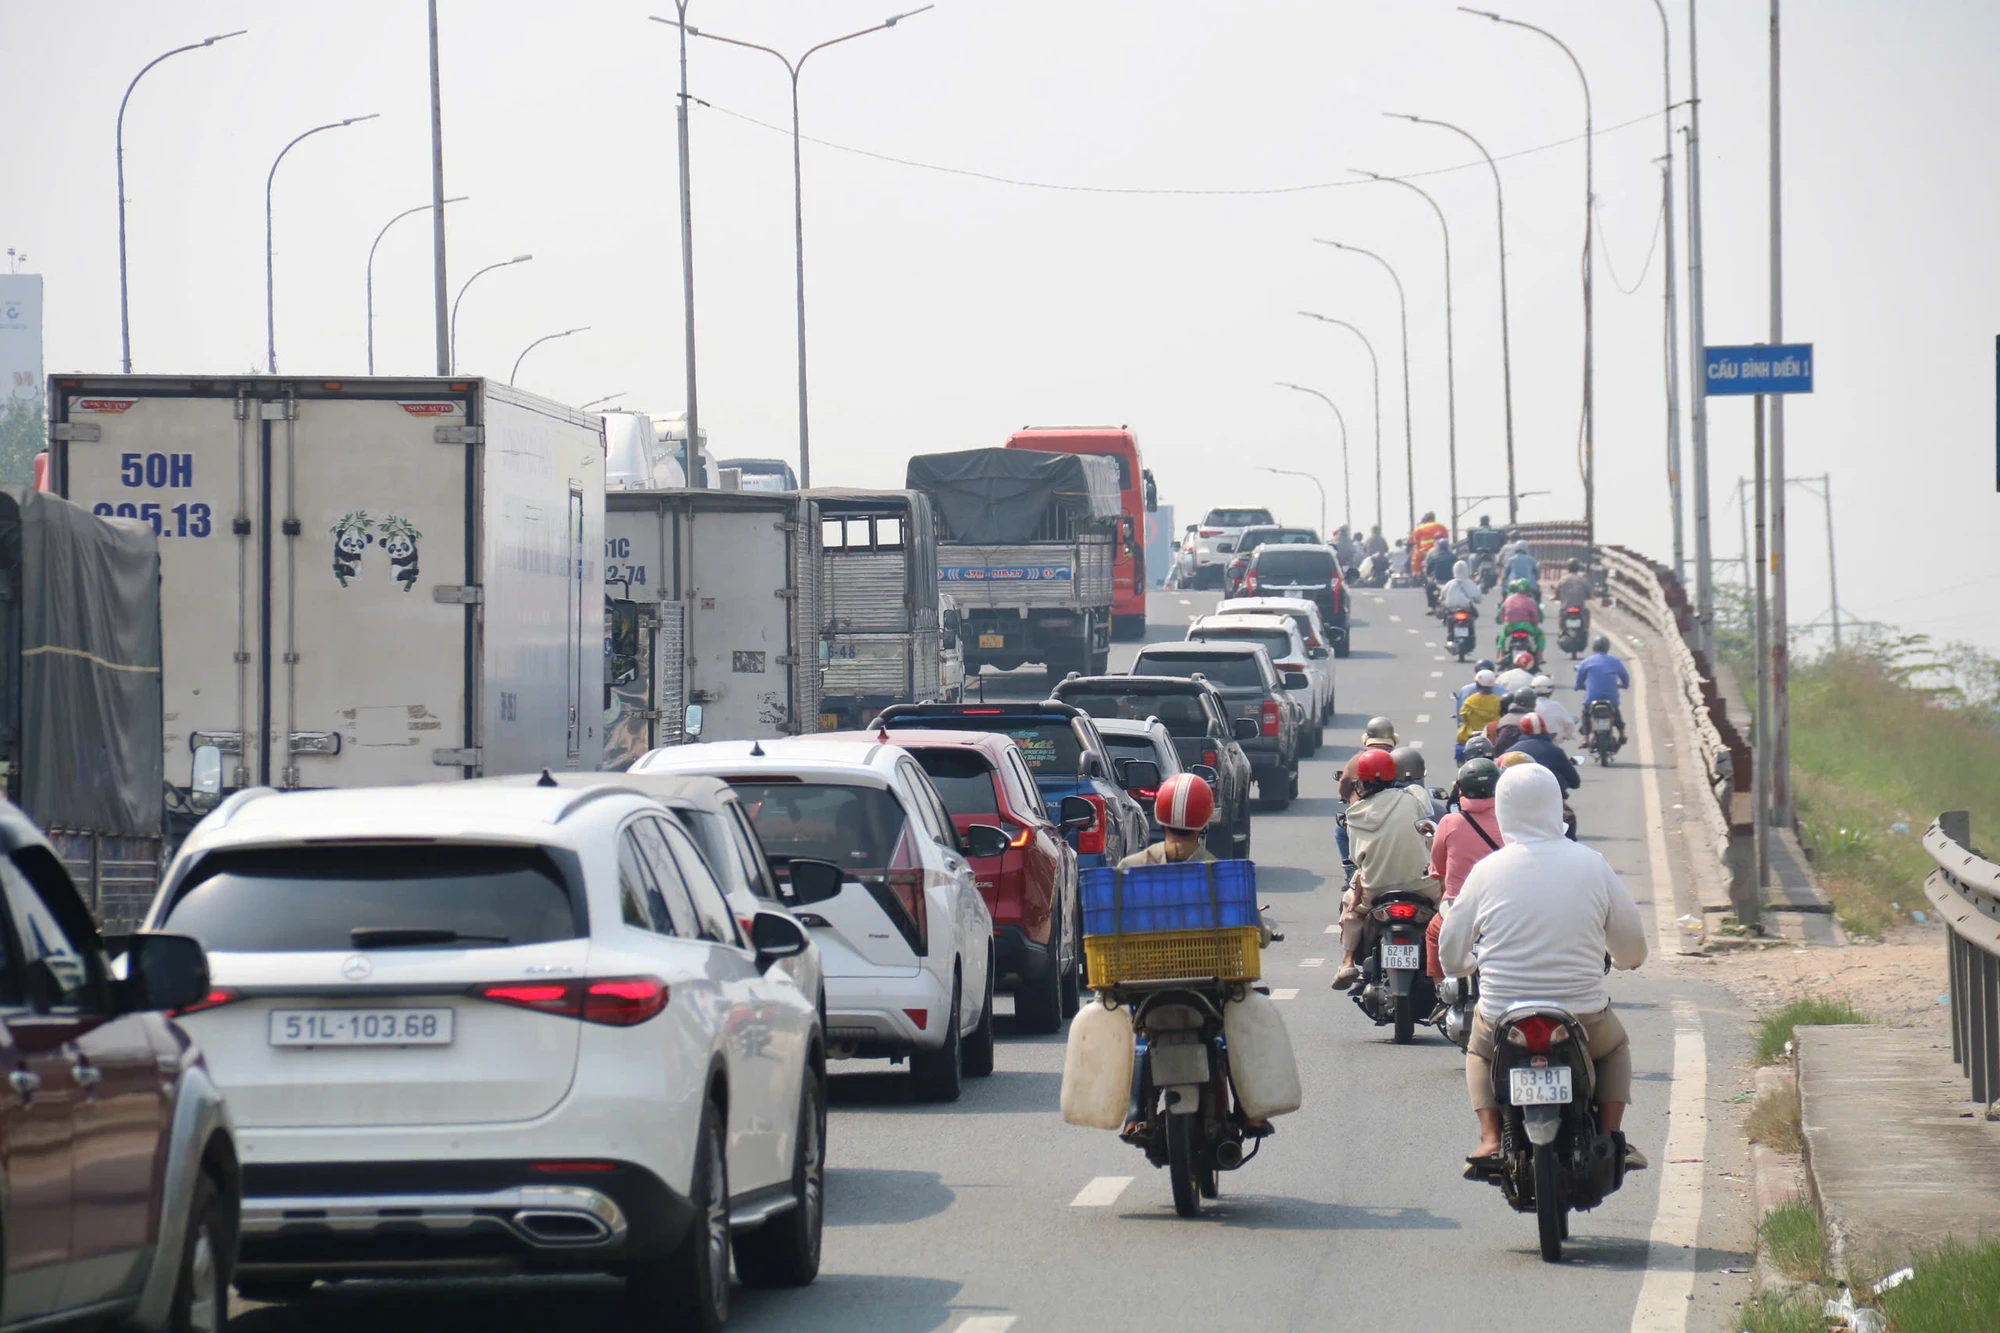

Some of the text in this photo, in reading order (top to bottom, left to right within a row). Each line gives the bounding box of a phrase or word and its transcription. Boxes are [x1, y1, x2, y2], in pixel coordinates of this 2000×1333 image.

[1802, 361, 1809, 377] 1
[121, 452, 192, 488] 50H
[604, 537, 630, 559] 1C
[604, 565, 647, 586] 2-74
[1387, 945, 1414, 957] 62-AP
[1385, 957, 1418, 968] 106.58
[285, 1015, 438, 1039] 51L-103.68
[1520, 1070, 1561, 1086] 63-B1
[1515, 1086, 1569, 1102] 294.36
